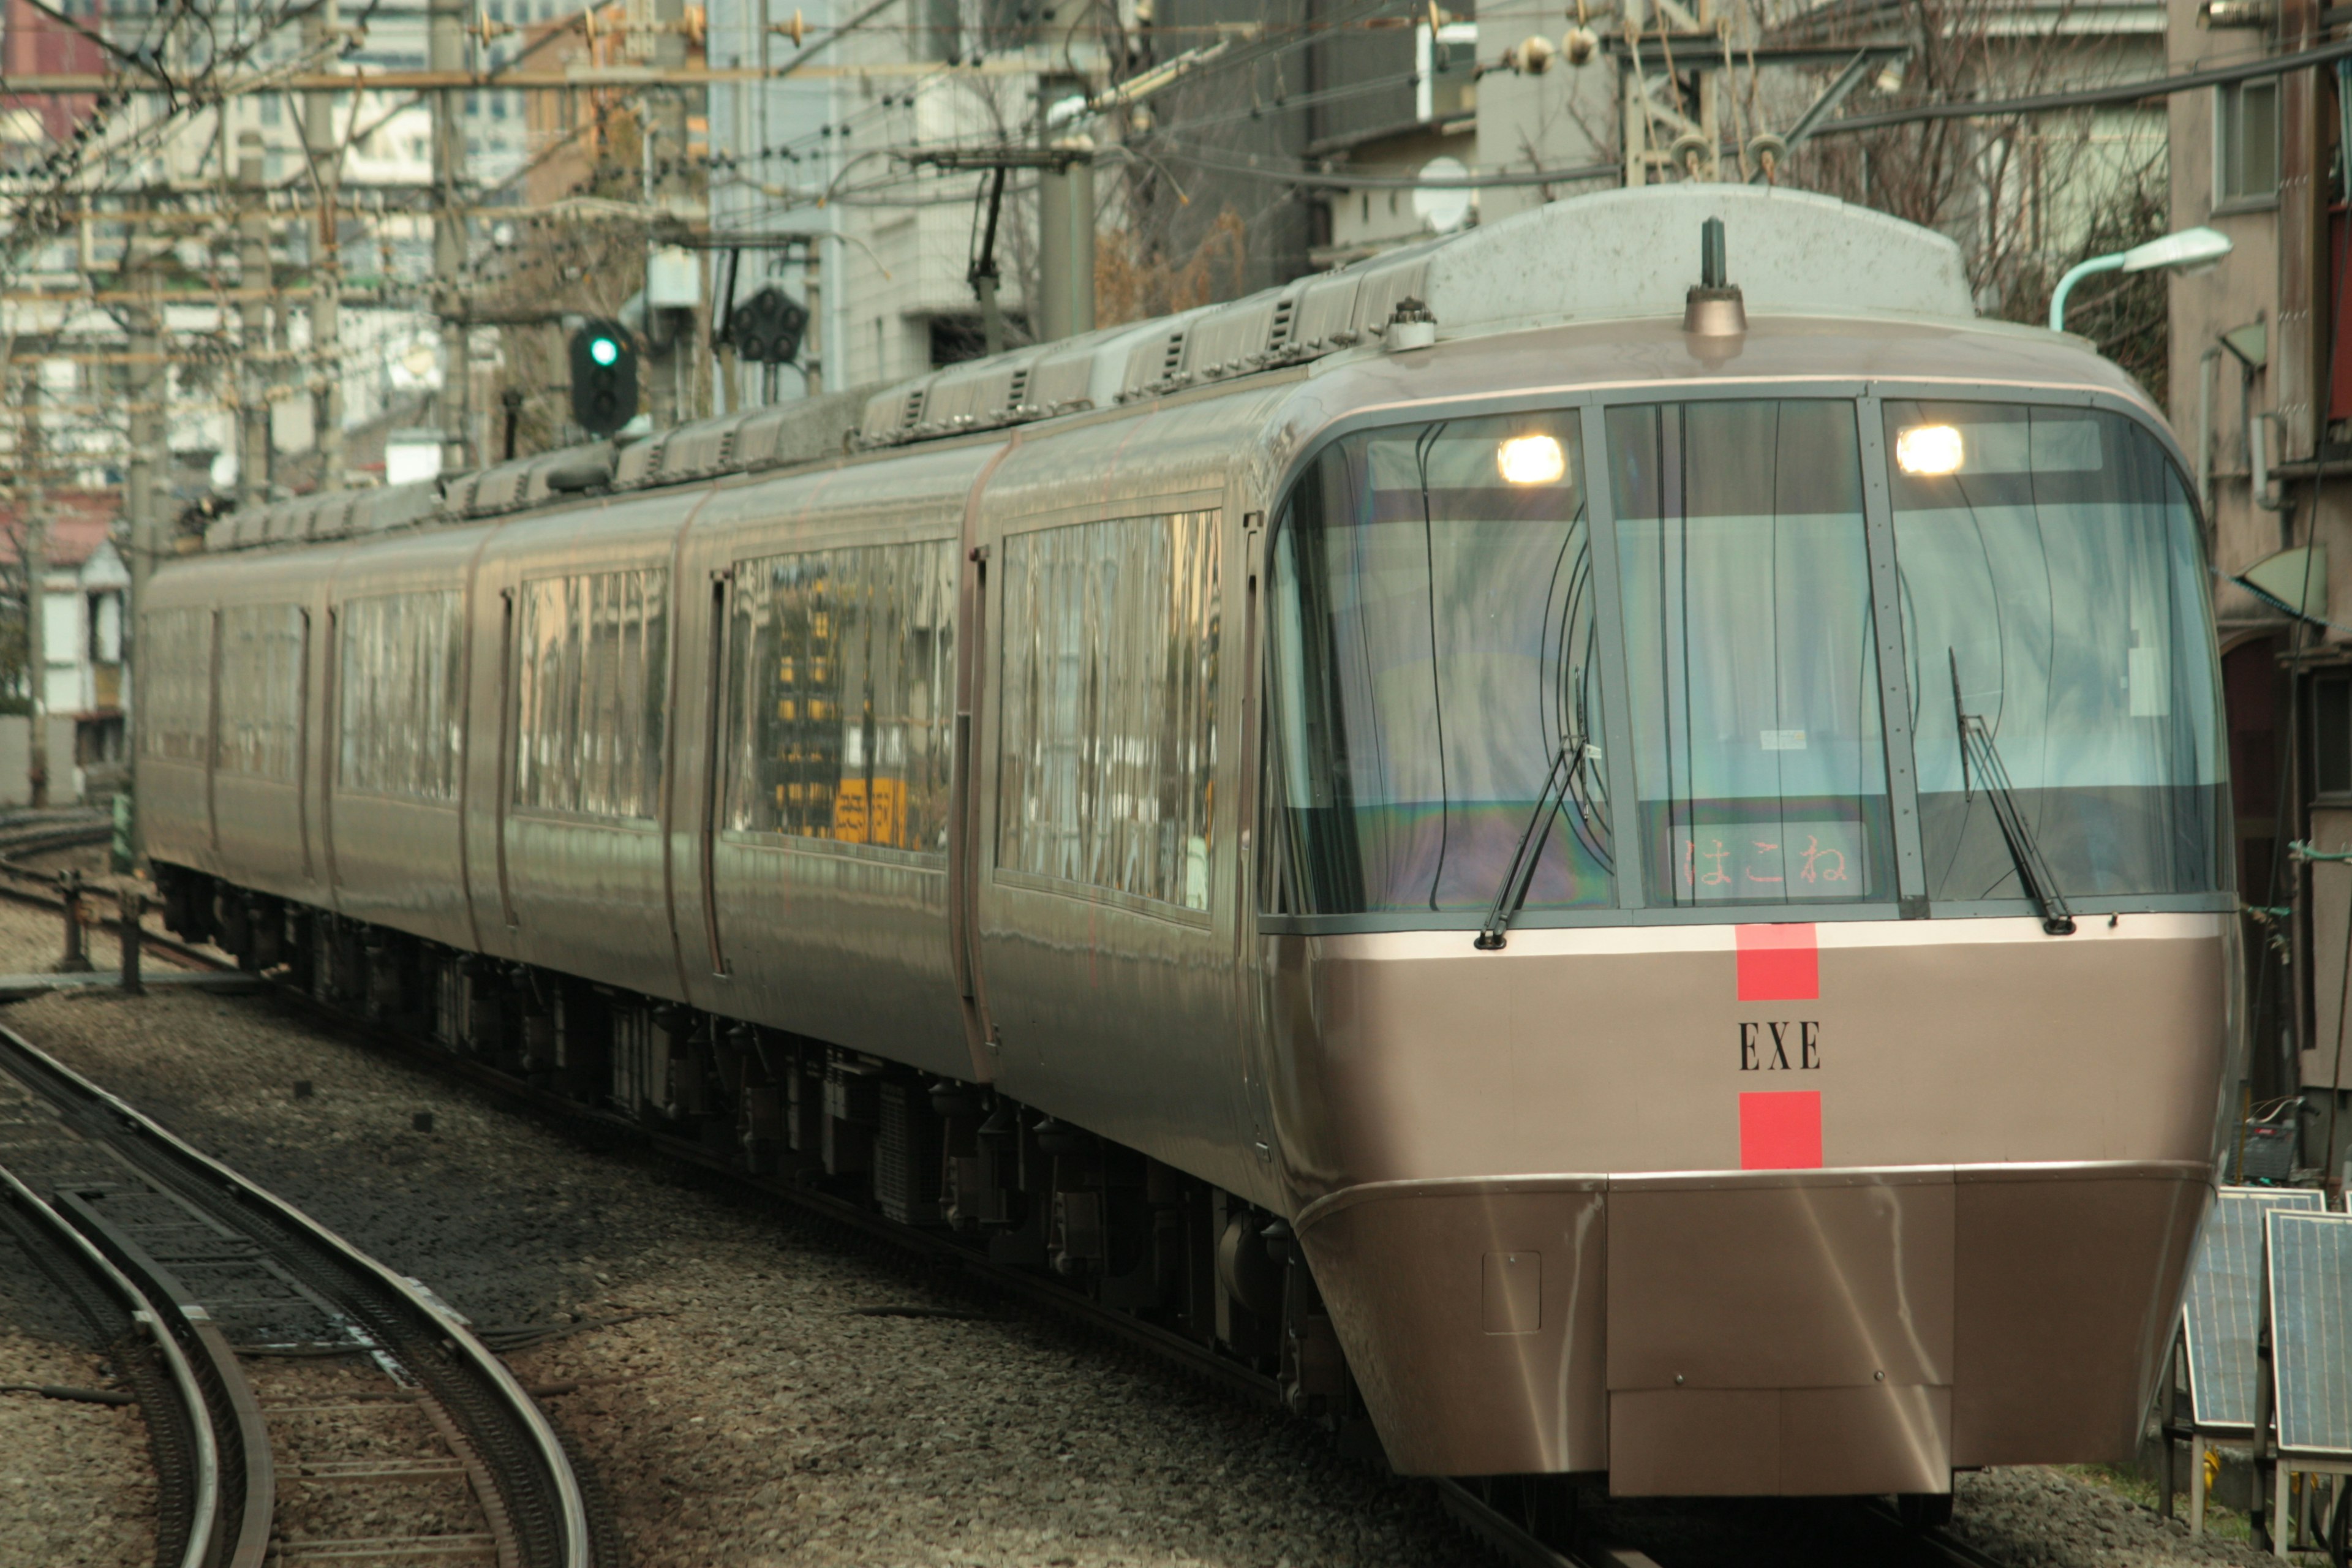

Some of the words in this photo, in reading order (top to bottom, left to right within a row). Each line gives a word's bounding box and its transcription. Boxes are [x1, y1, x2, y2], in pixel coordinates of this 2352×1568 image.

[1684, 835, 1847, 886] はこね
[1738, 1021, 1820, 1071] EXE
